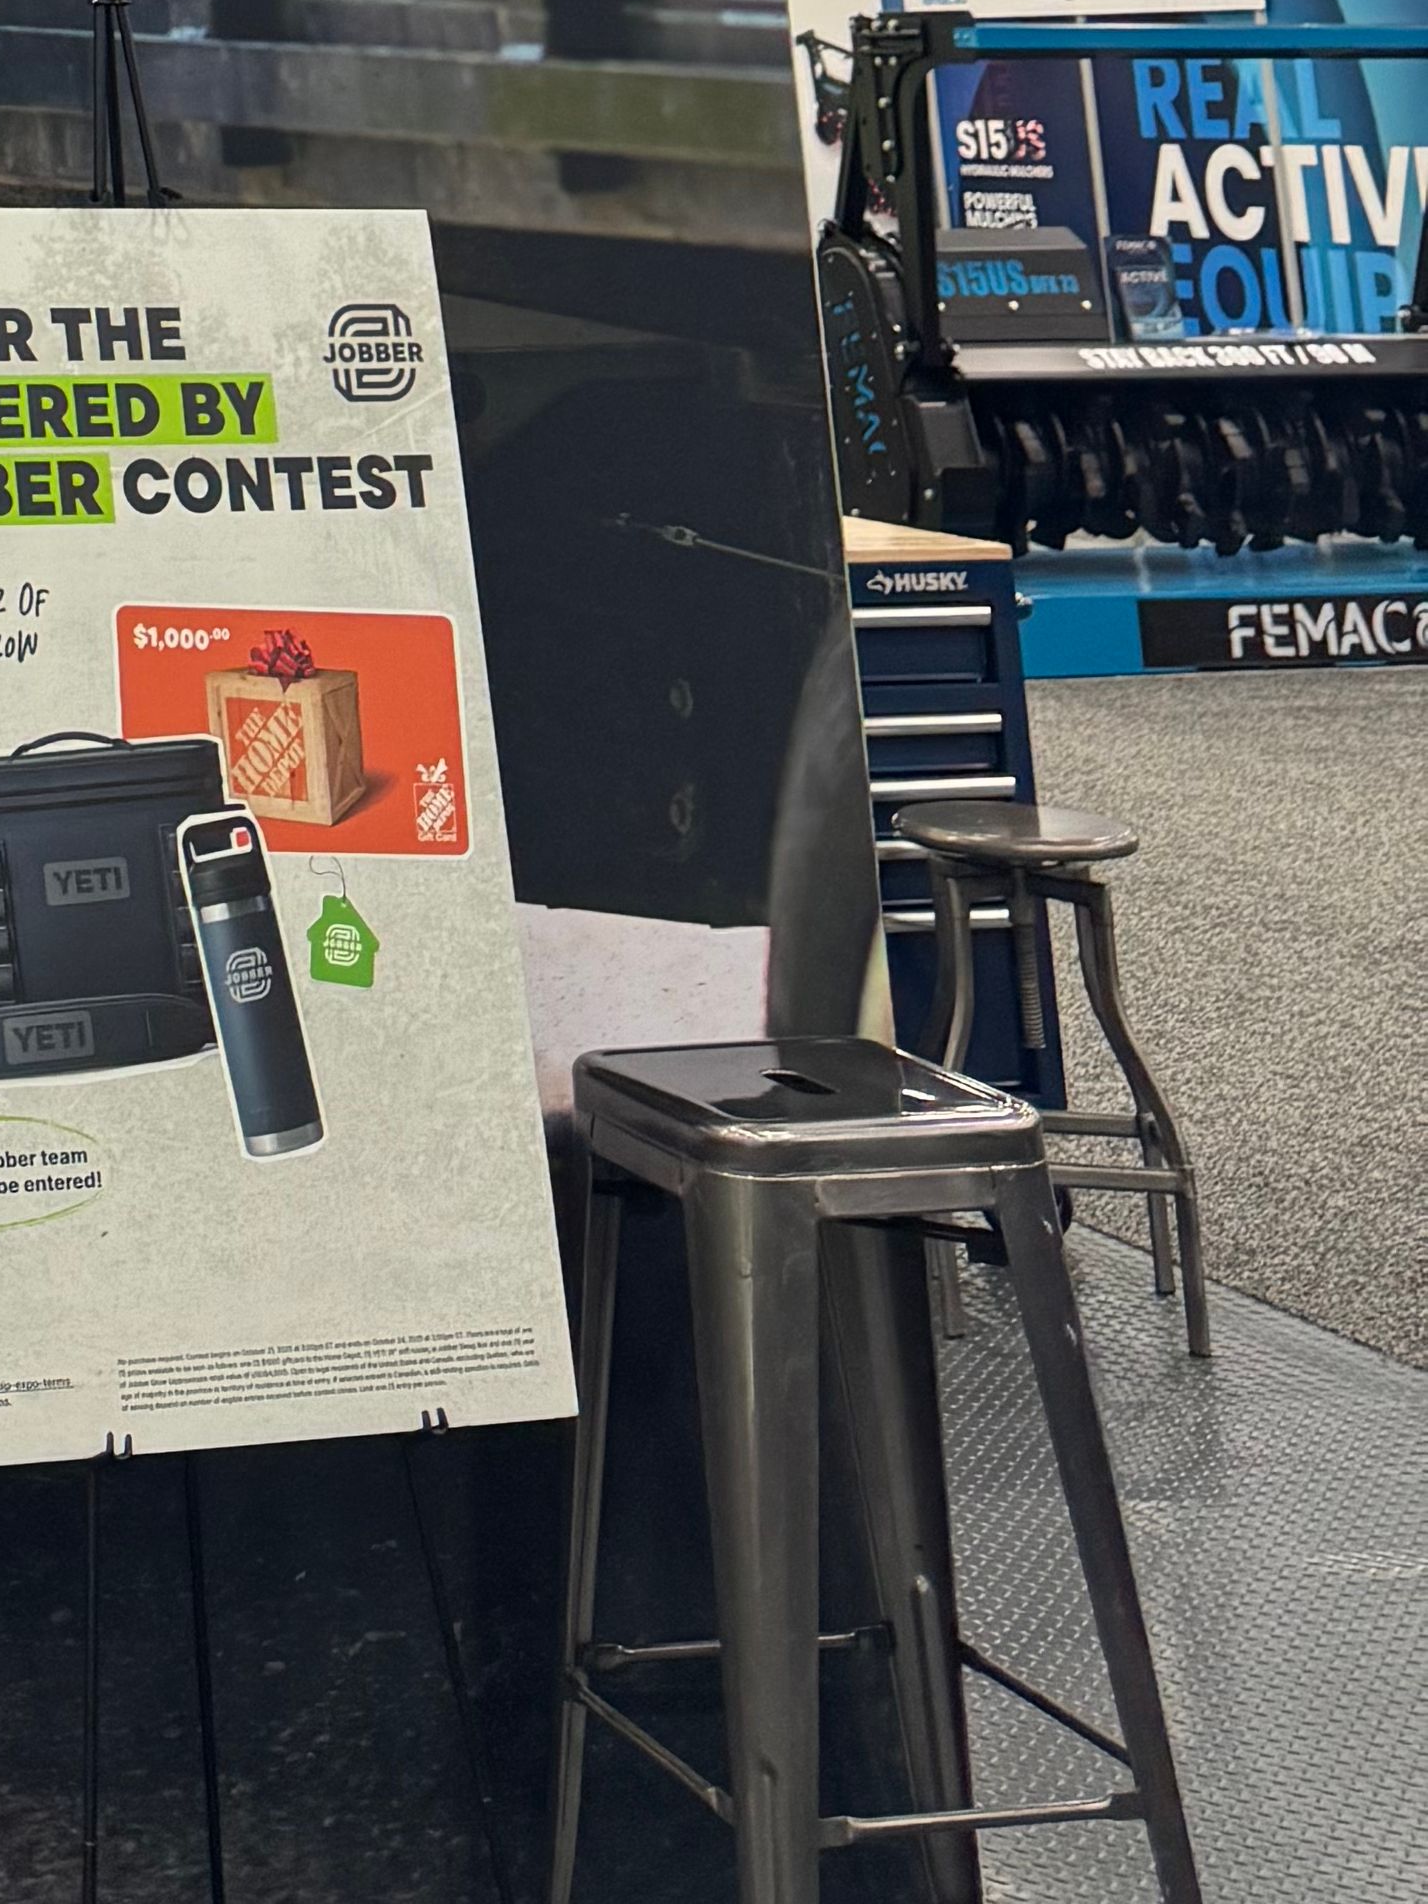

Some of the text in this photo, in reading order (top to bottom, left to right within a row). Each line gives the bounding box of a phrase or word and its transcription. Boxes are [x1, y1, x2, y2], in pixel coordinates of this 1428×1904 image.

[1132, 58, 1342, 141] REAL
[50, 305, 188, 362] THE
[321, 341, 425, 366] JOBBER
[182, 380, 267, 437] BY
[121, 453, 435, 516] CONTEST
[18, 581, 52, 618] OF
[894, 571, 969, 593] HUSKY
[1227, 600, 1413, 659] FEMAC
[234, 705, 269, 747] THE
[231, 701, 305, 796] HOME
[260, 737, 307, 798] DEPOT
[415, 783, 456, 833] HOME
[51, 866, 124, 896] YETI
[224, 965, 274, 986] JOBBER
[10, 1019, 88, 1054] YETI
[41, 1149, 88, 1167] team
[24, 1171, 103, 1194] entered!
